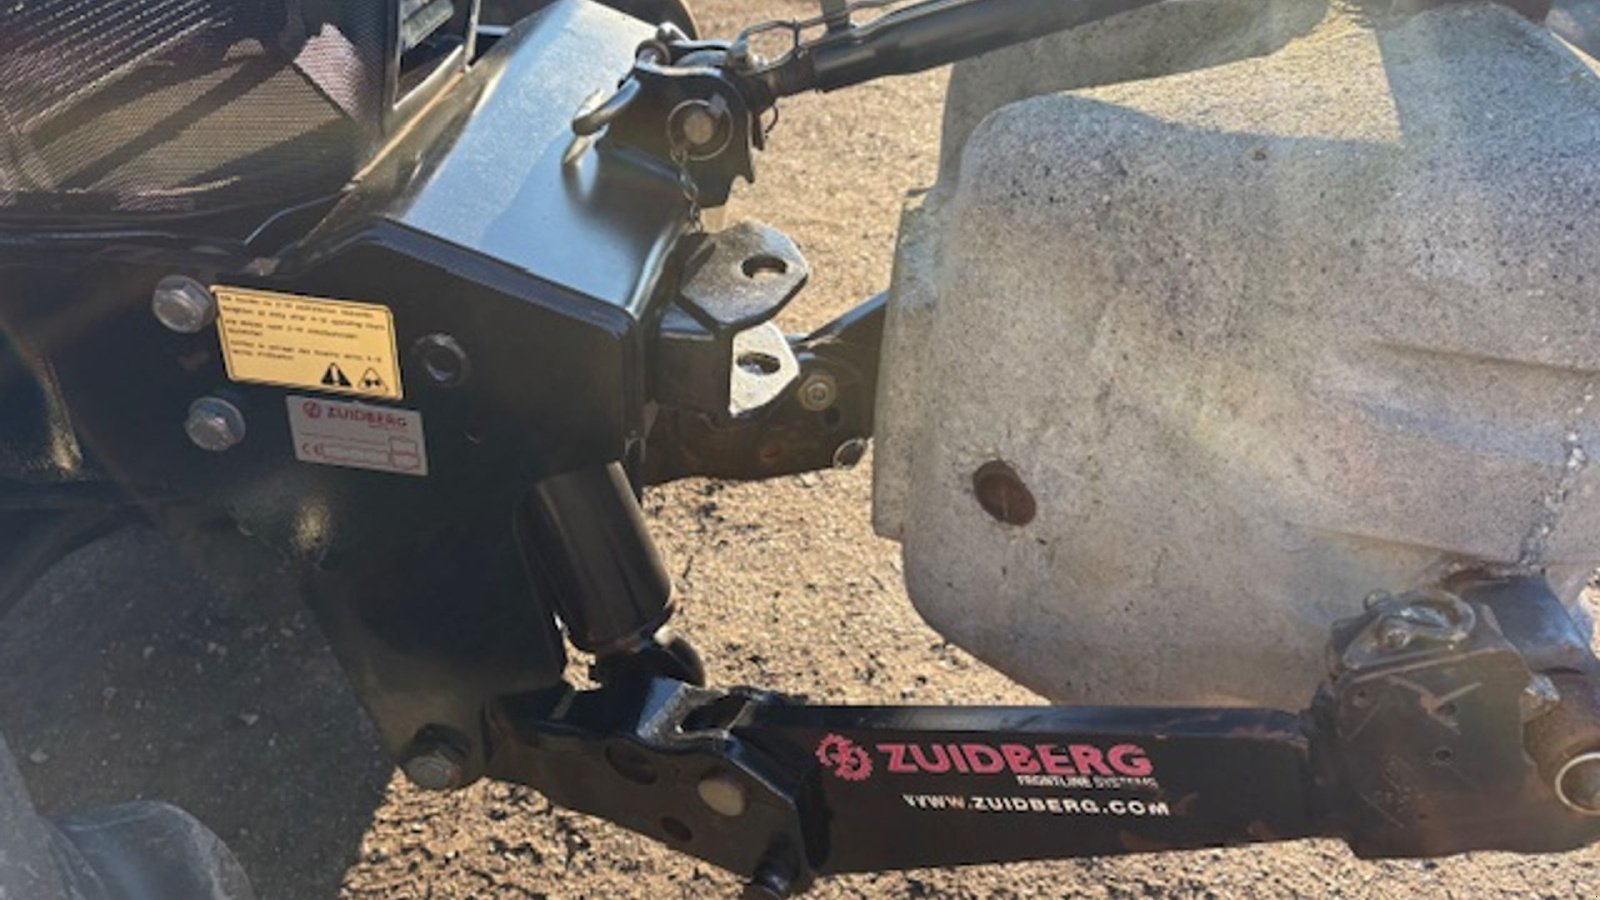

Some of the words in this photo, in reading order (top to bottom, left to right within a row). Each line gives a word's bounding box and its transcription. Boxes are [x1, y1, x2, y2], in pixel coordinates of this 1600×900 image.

[327, 406, 408, 428] ZUIDBERG
[875, 743, 1153, 776] ZUIDBERG
[902, 793, 1170, 816] WWW.ZUIDBERG.COM
